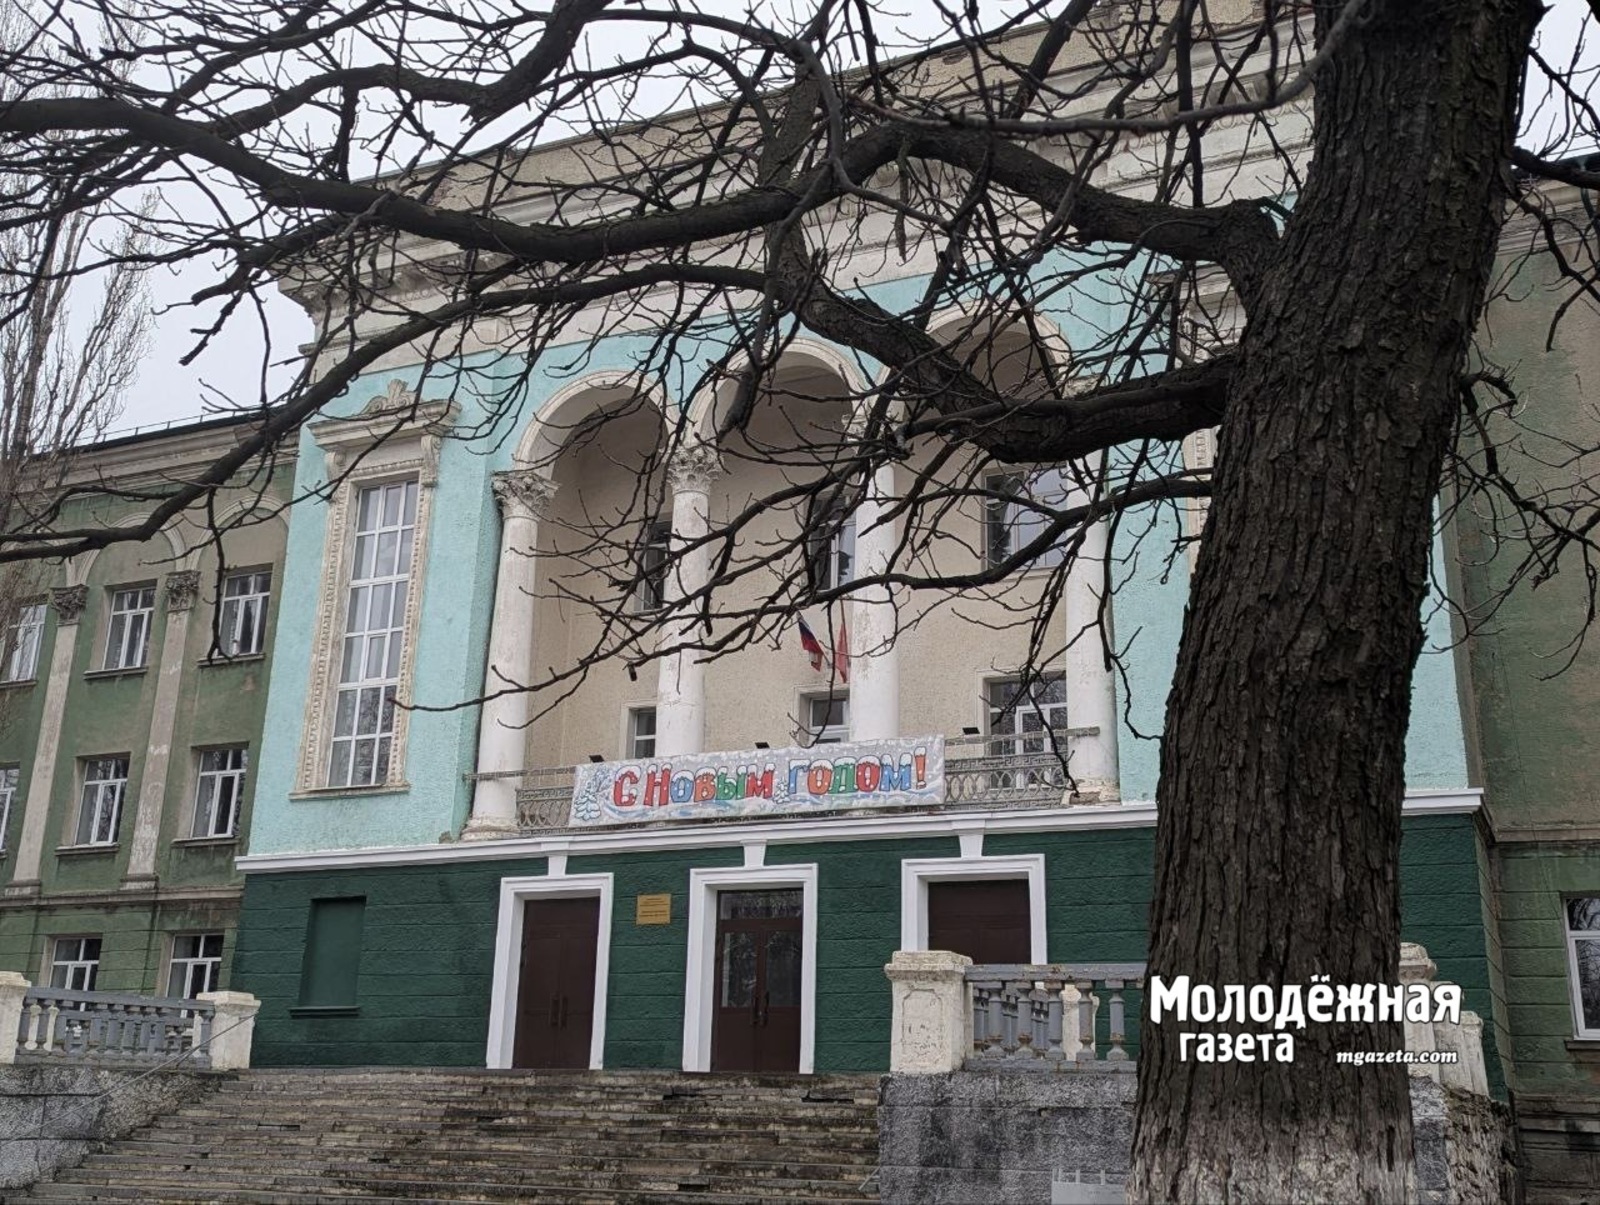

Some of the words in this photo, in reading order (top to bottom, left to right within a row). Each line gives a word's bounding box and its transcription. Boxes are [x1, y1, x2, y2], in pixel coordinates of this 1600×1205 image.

[613, 765, 641, 807] С
[643, 762, 776, 807] НОВЫМ
[787, 746, 927, 795] ГОДОМ!
